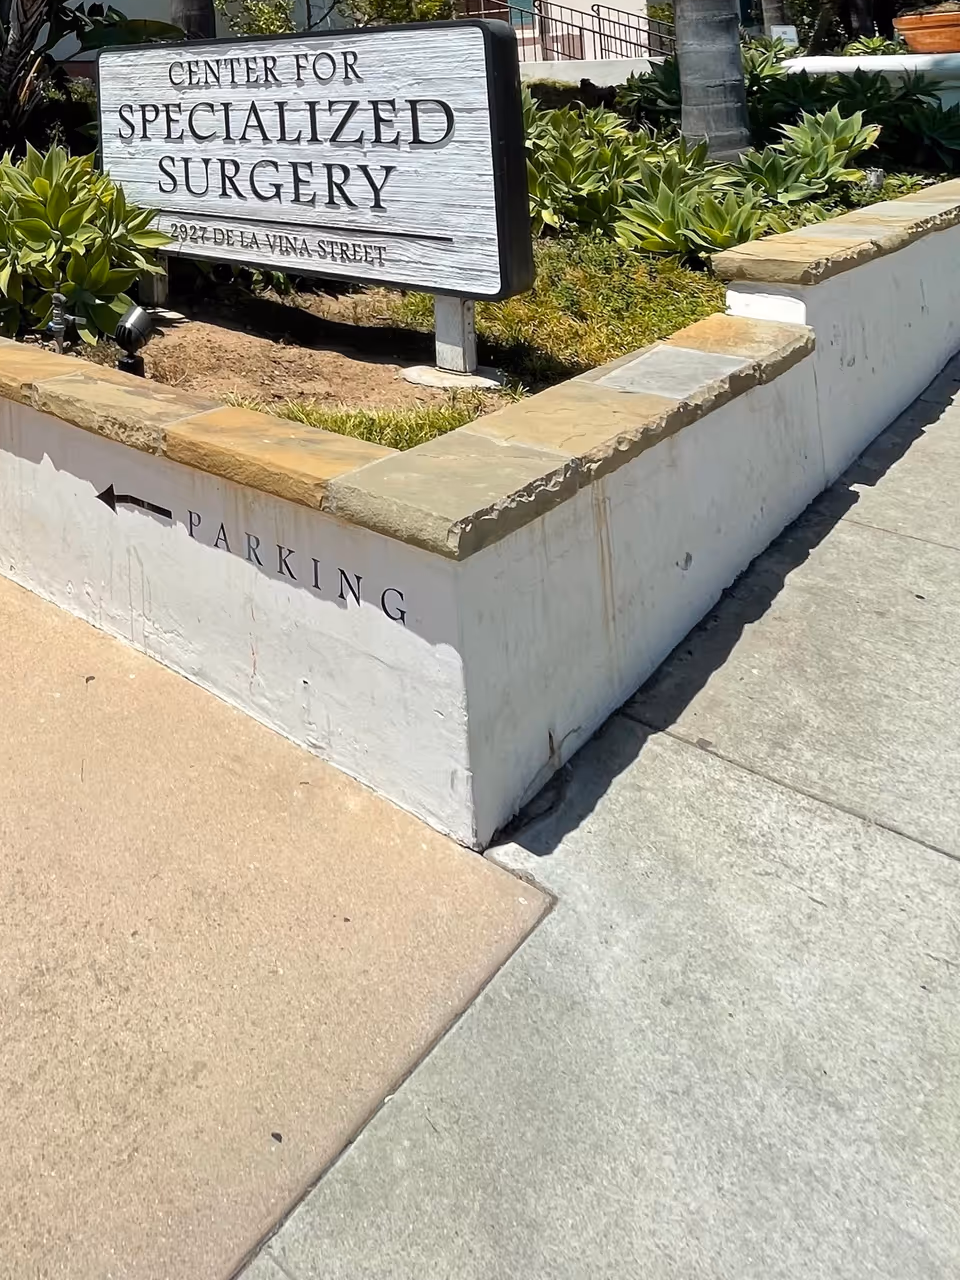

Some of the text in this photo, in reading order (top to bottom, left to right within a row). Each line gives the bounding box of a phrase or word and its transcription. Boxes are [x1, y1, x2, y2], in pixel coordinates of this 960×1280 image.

[168, 50, 363, 86] CENTER FOR
[118, 98, 455, 145] SPECIALIZED
[158, 155, 397, 209] SURGERY
[170, 222, 387, 266] 2927 DE LA VINA STREET
[187, 510, 407, 627] PARKING
